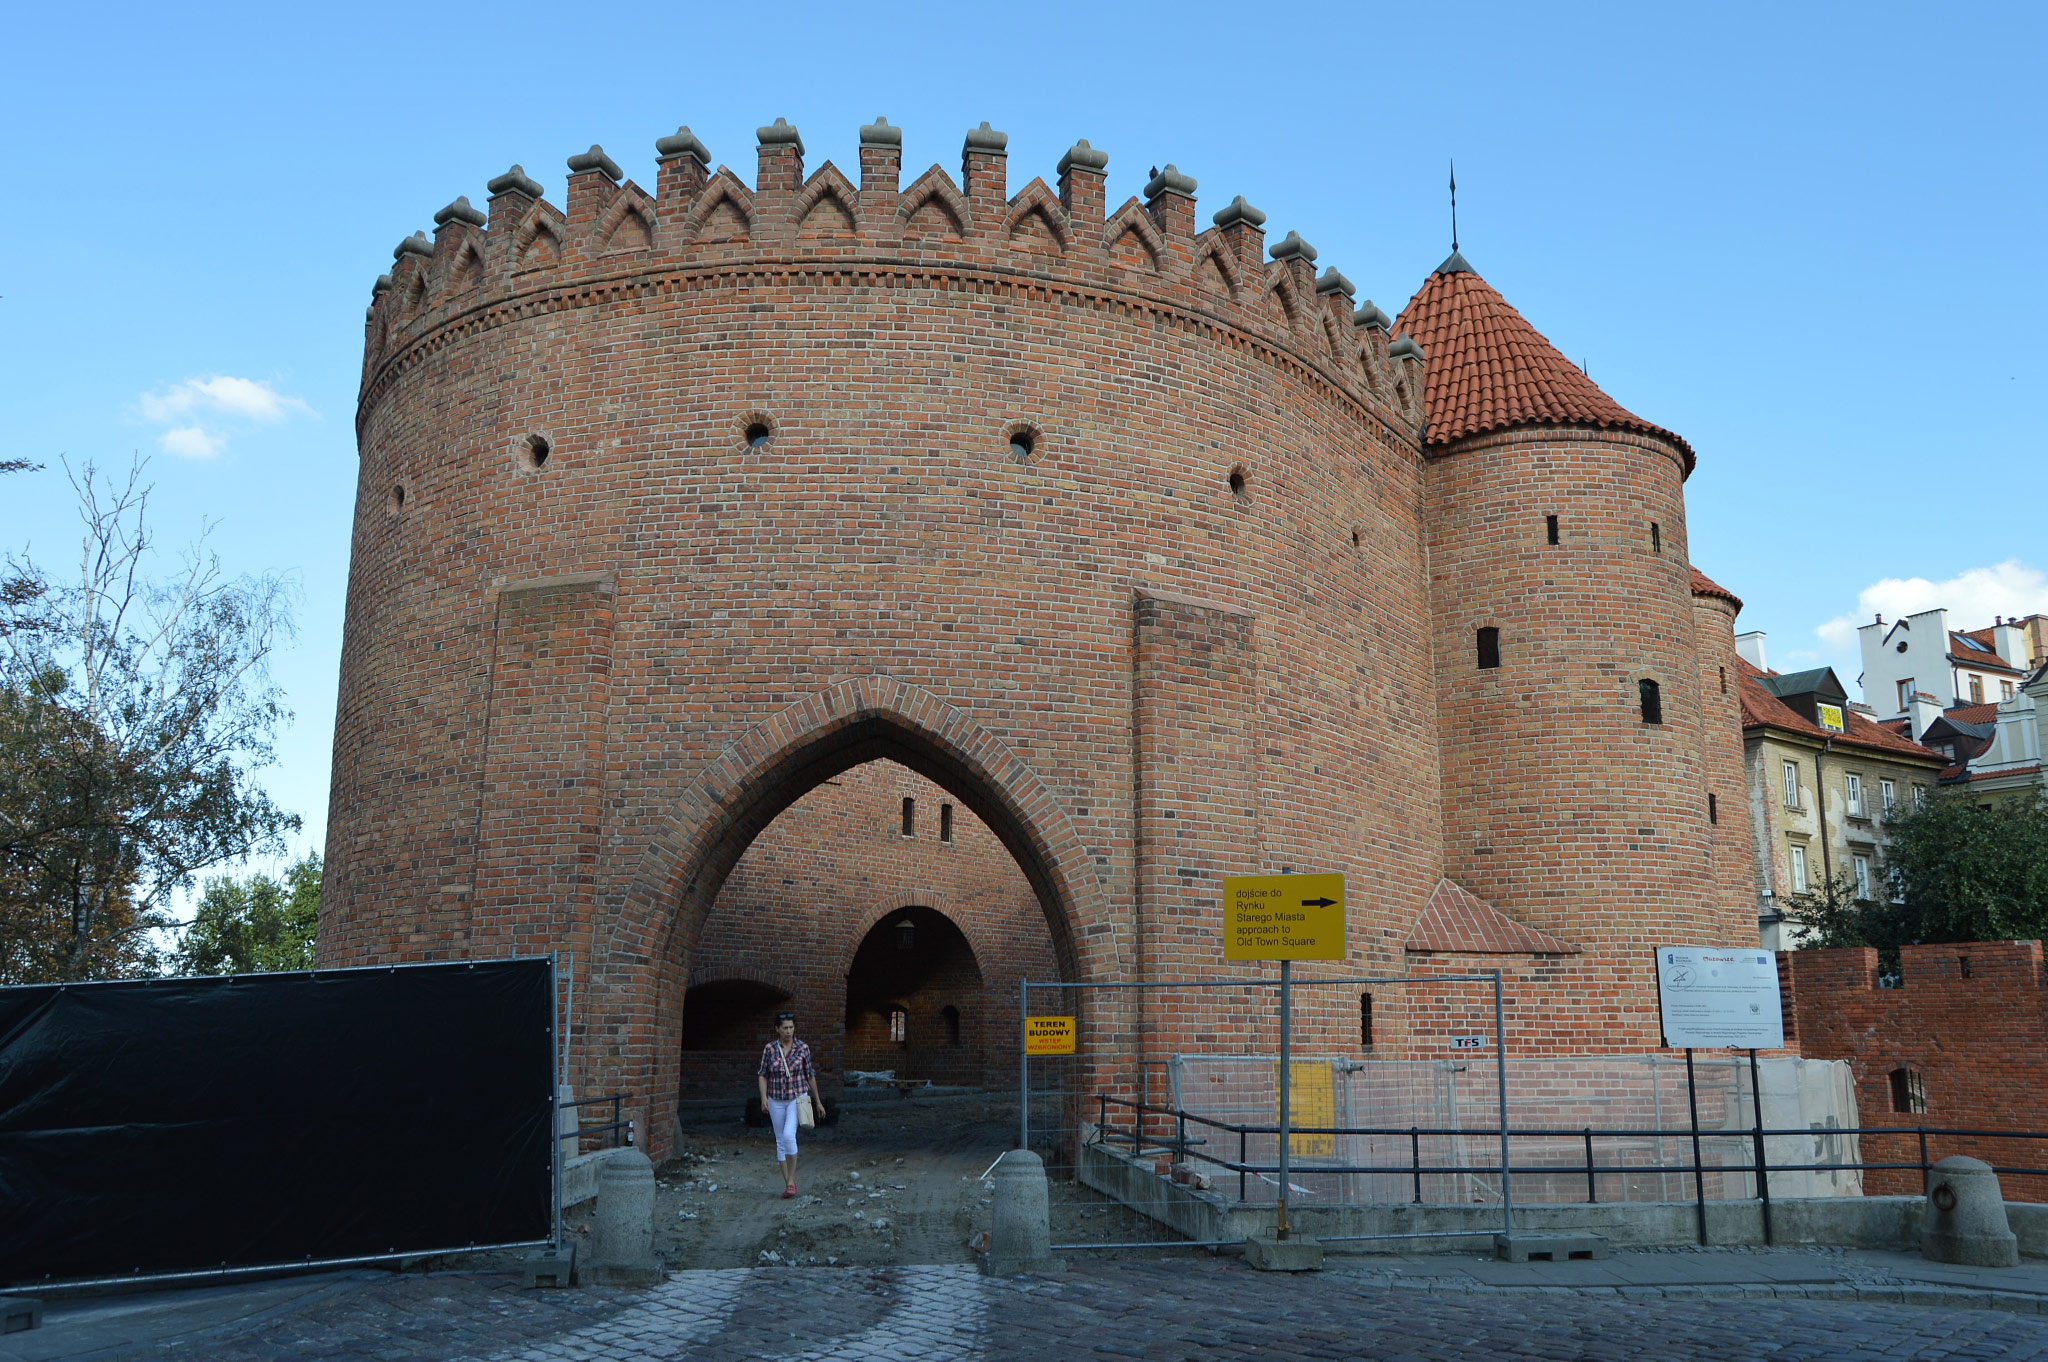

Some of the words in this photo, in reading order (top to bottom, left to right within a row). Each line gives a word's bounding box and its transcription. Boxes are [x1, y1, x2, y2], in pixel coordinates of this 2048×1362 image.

[1236, 888, 1268, 900] dojście
[1270, 889, 1282, 897] do
[1236, 901, 1265, 912] Rynku
[1236, 913, 1272, 924] Starego
[1275, 912, 1306, 922] Miasta
[1236, 925, 1279, 936] approach
[1282, 925, 1291, 934] to
[1236, 937, 1253, 947] Old
[1256, 937, 1279, 946] Town
[1282, 936, 1316, 948] Square
[1455, 1038, 1479, 1047] TFS
